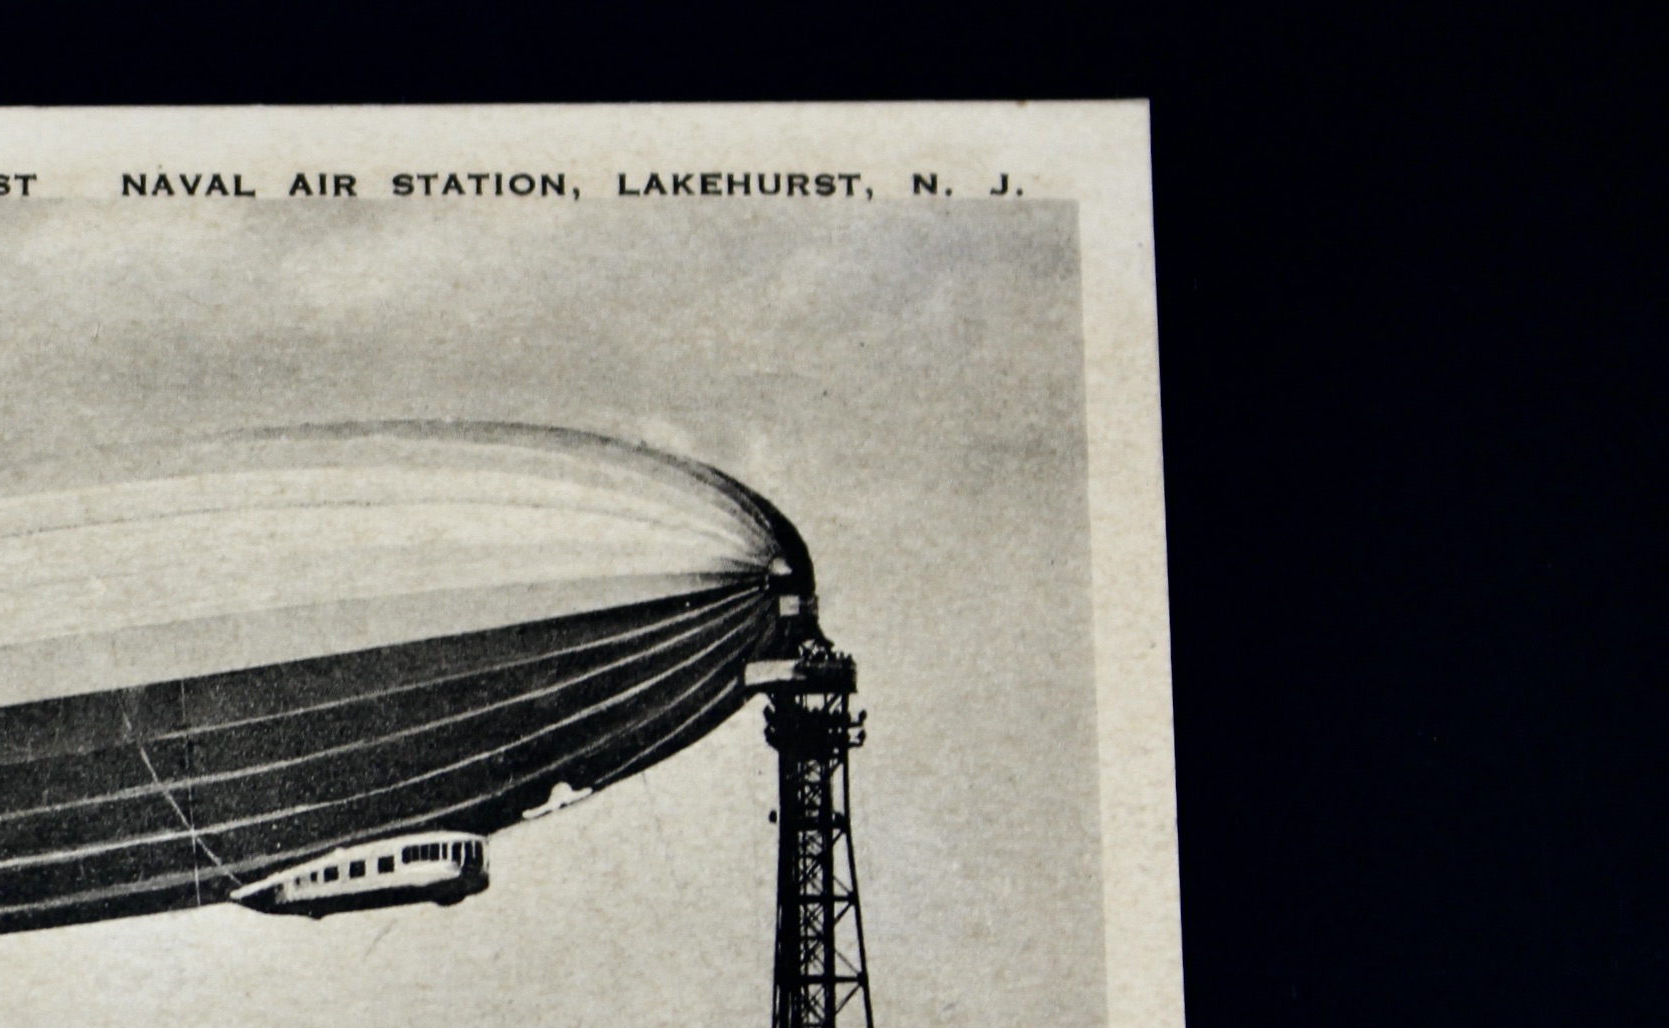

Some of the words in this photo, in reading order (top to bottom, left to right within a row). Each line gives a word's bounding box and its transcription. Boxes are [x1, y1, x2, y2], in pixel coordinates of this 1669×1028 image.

[122, 174, 255, 197] NAVAL
[289, 173, 356, 197] AIR
[392, 173, 580, 200] STATION,
[619, 173, 872, 200] LAKEHURST,
[913, 174, 952, 196] N.
[990, 174, 1022, 196] J.
